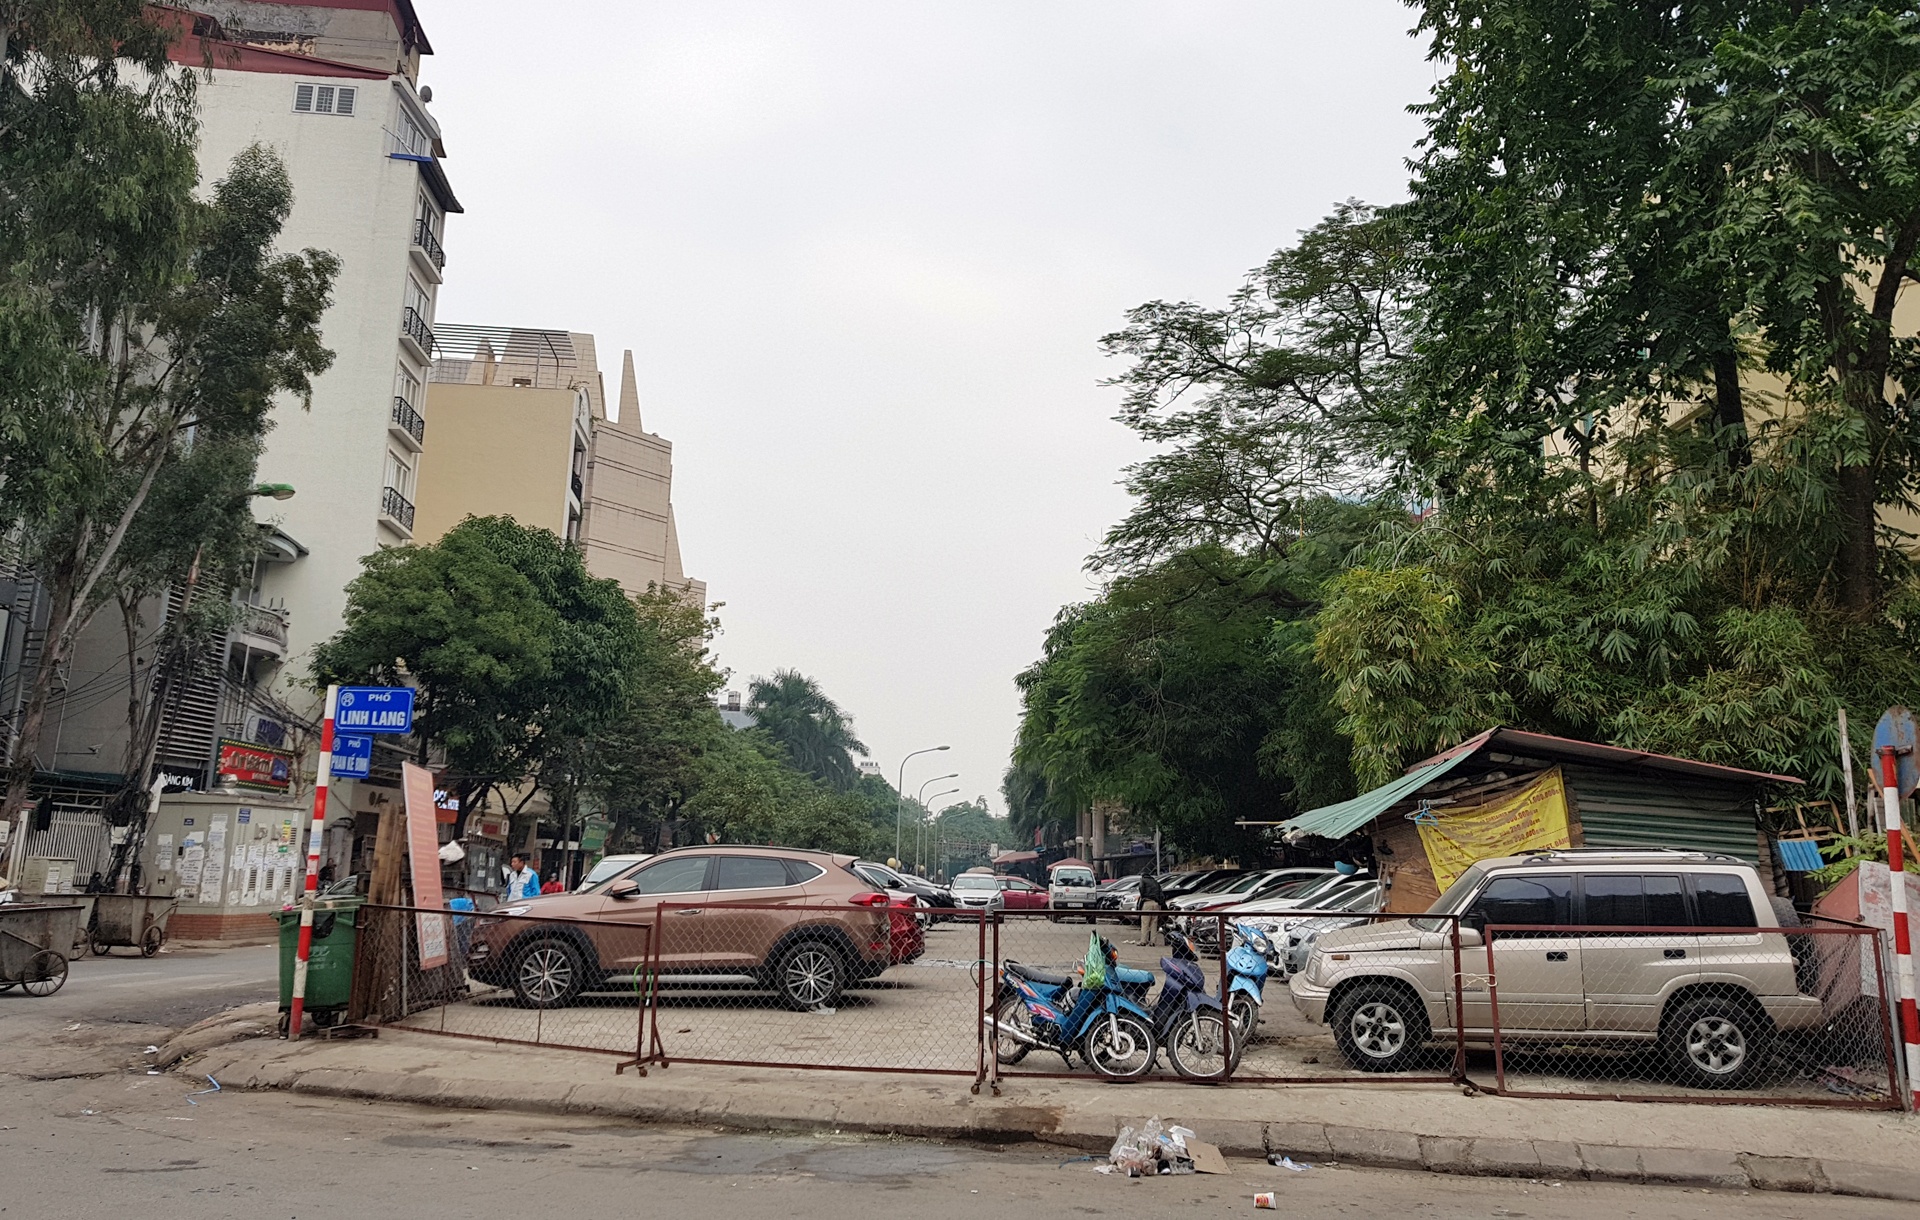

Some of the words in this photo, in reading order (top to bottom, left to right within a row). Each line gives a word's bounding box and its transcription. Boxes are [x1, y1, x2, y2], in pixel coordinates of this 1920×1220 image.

[368, 690, 392, 702] PHỐ
[340, 710, 370, 725] LINH
[371, 710, 406, 727] LANG
[347, 737, 362, 748] PHỐ
